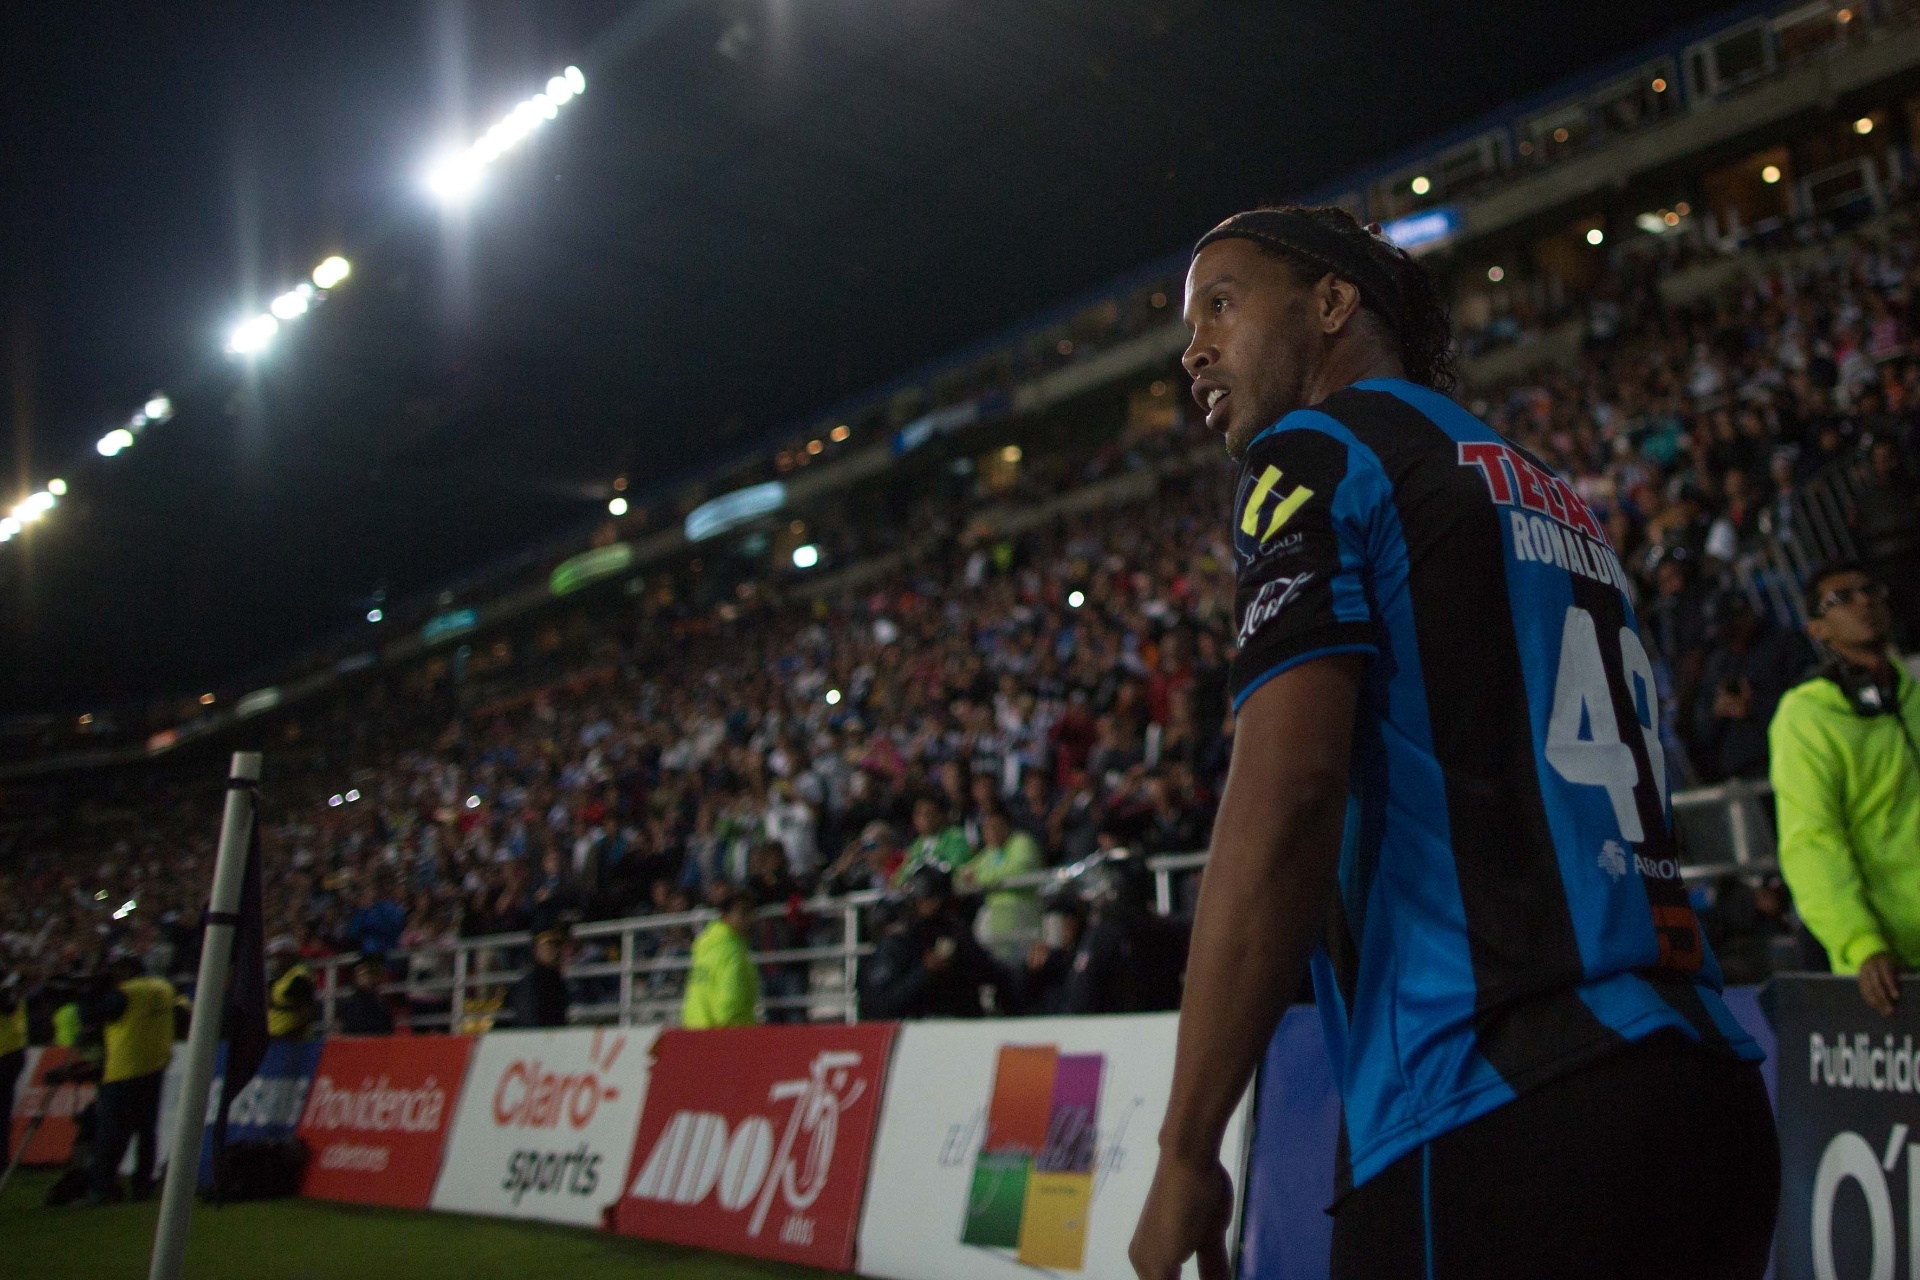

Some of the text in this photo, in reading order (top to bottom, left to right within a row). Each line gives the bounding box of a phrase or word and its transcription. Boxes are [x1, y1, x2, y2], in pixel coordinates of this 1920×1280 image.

[1510, 511, 1632, 599] RONALDI
[491, 1059, 600, 1132] Claro
[503, 1142, 602, 1206] sports
